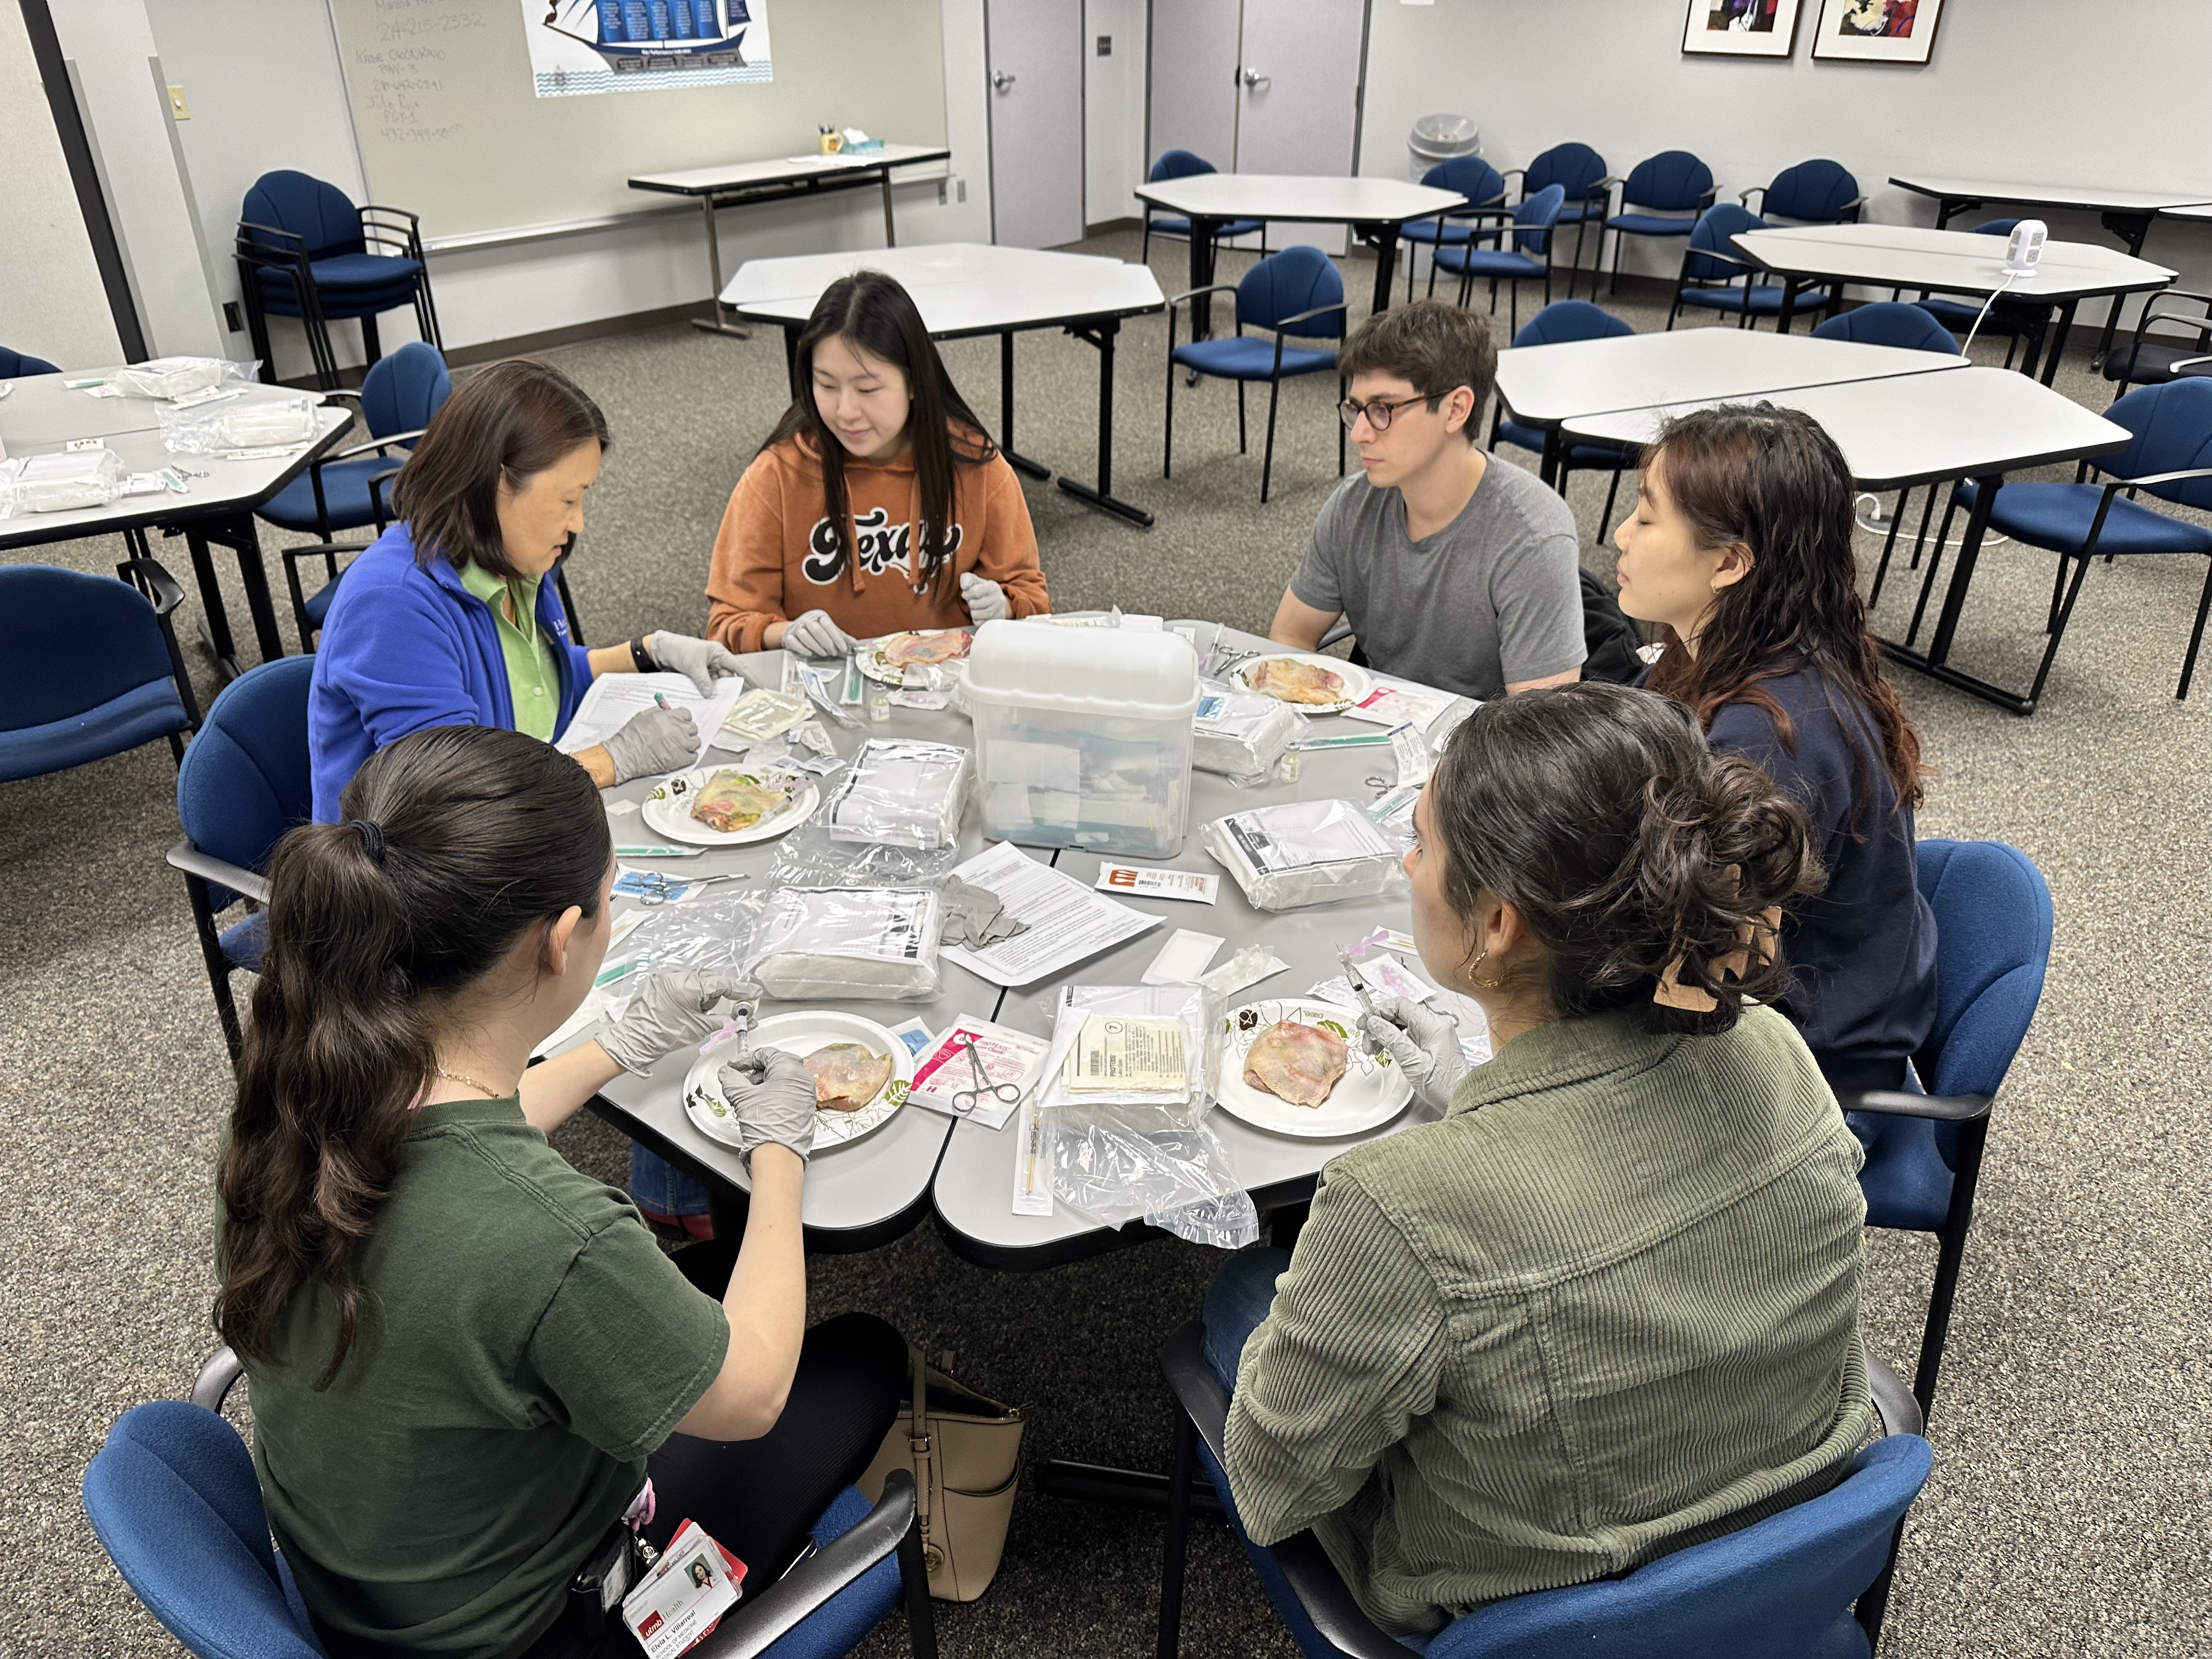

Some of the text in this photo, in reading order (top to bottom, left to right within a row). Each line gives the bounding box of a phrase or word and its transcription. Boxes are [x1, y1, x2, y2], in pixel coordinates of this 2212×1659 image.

[662, 1599, 684, 1621] Health
[645, 1618, 662, 1637] utmb
[651, 1638, 665, 1653] Elvia
[670, 1610, 696, 1633] Villarreal
[676, 1629, 694, 1648] STUDENT
[656, 1644, 673, 1659] SCHOOL
[678, 1620, 697, 1639] MEDICINE
